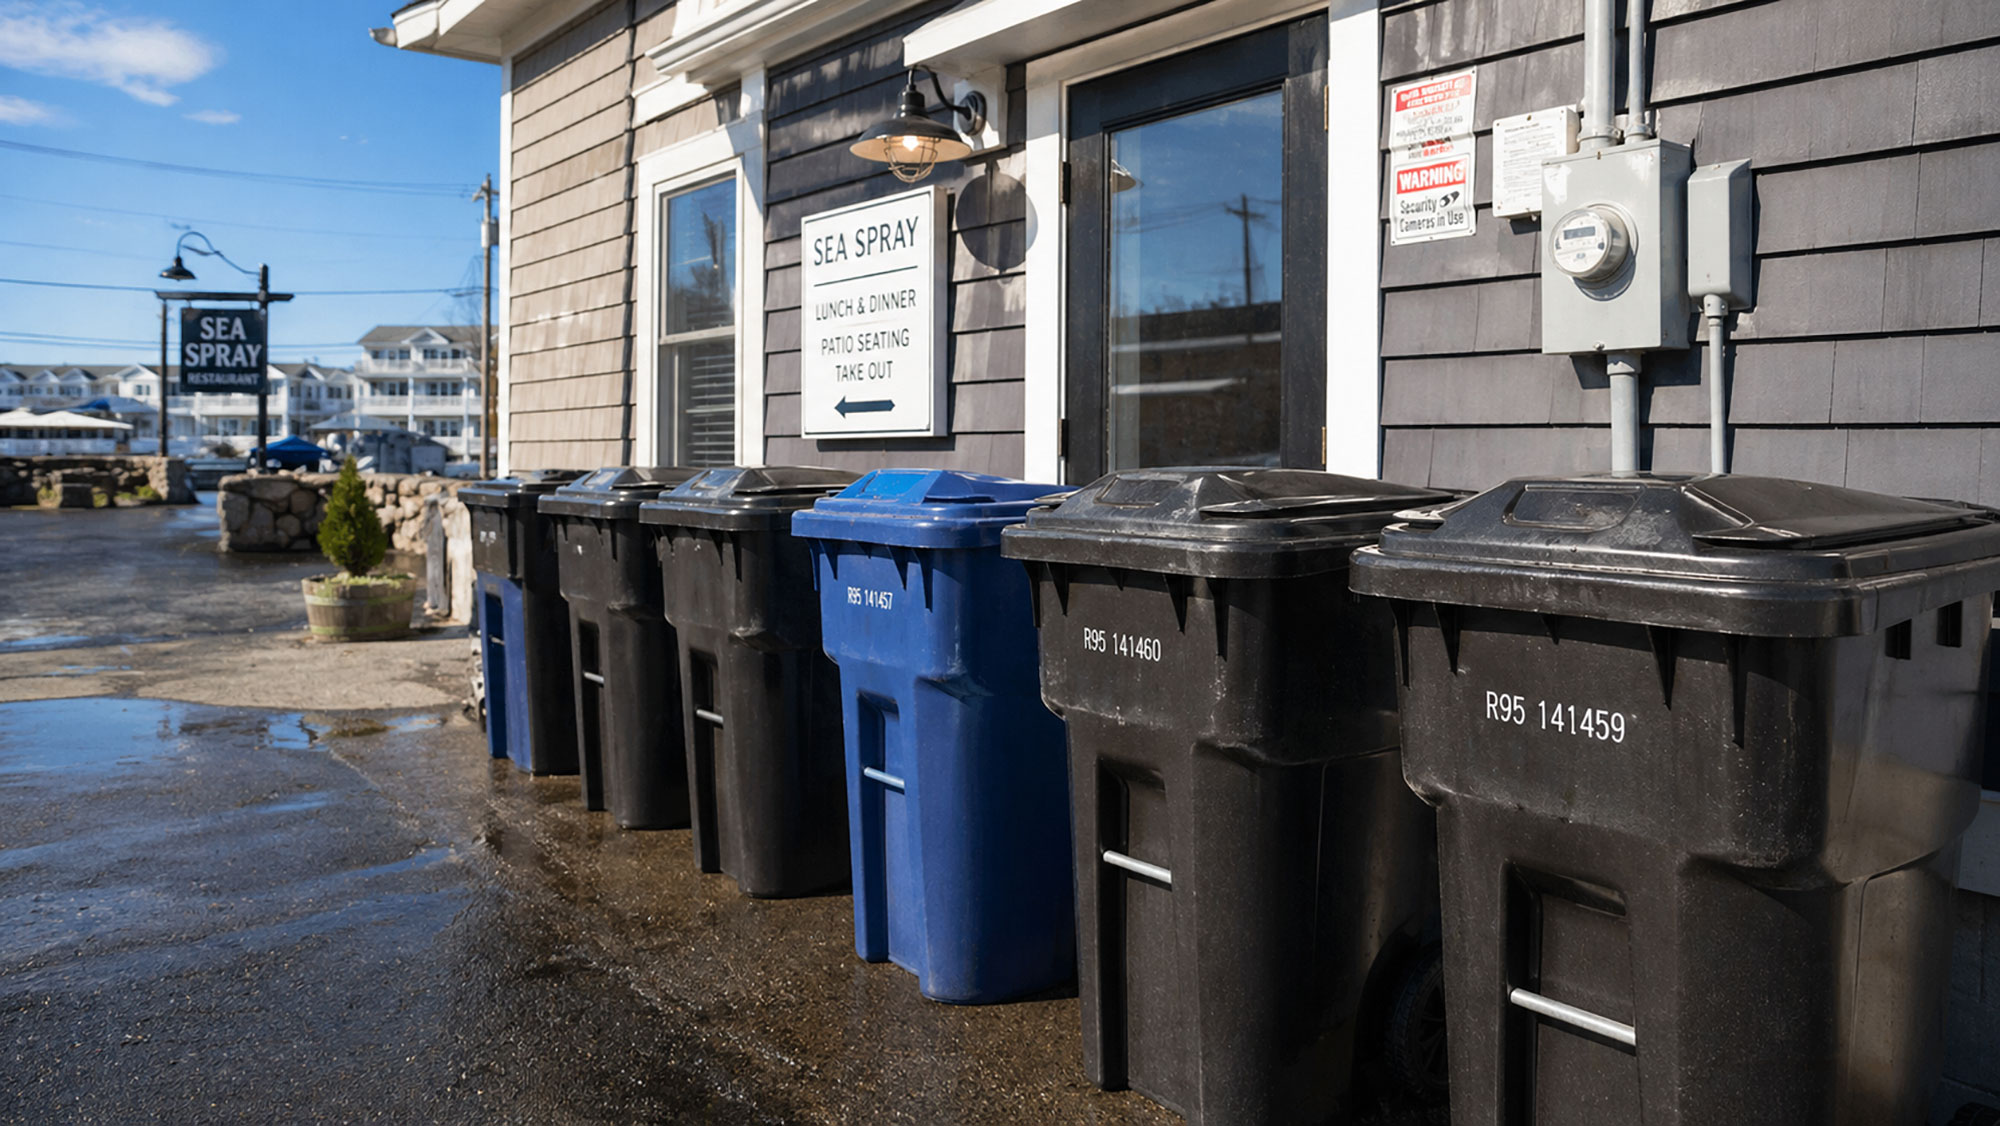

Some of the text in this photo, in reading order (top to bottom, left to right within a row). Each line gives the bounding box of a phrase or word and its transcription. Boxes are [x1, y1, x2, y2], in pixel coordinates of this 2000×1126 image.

[1399, 160, 1465, 191] WARNING
[1400, 196, 1438, 215] Security
[1399, 211, 1464, 233] Cameras in Use
[813, 216, 919, 266] SEA SPRAY
[816, 289, 916, 321] LUNCH & DINNER
[200, 316, 247, 340] SEA
[184, 342, 262, 368] SPRAY
[821, 328, 910, 356] PATIO SEATING
[187, 372, 260, 385] RESTAURANT
[836, 360, 893, 382] TAKE OUT
[847, 586, 893, 610] R95 141457
[1084, 627, 1161, 662] R95 141460
[1486, 690, 1626, 743] R95 141459
